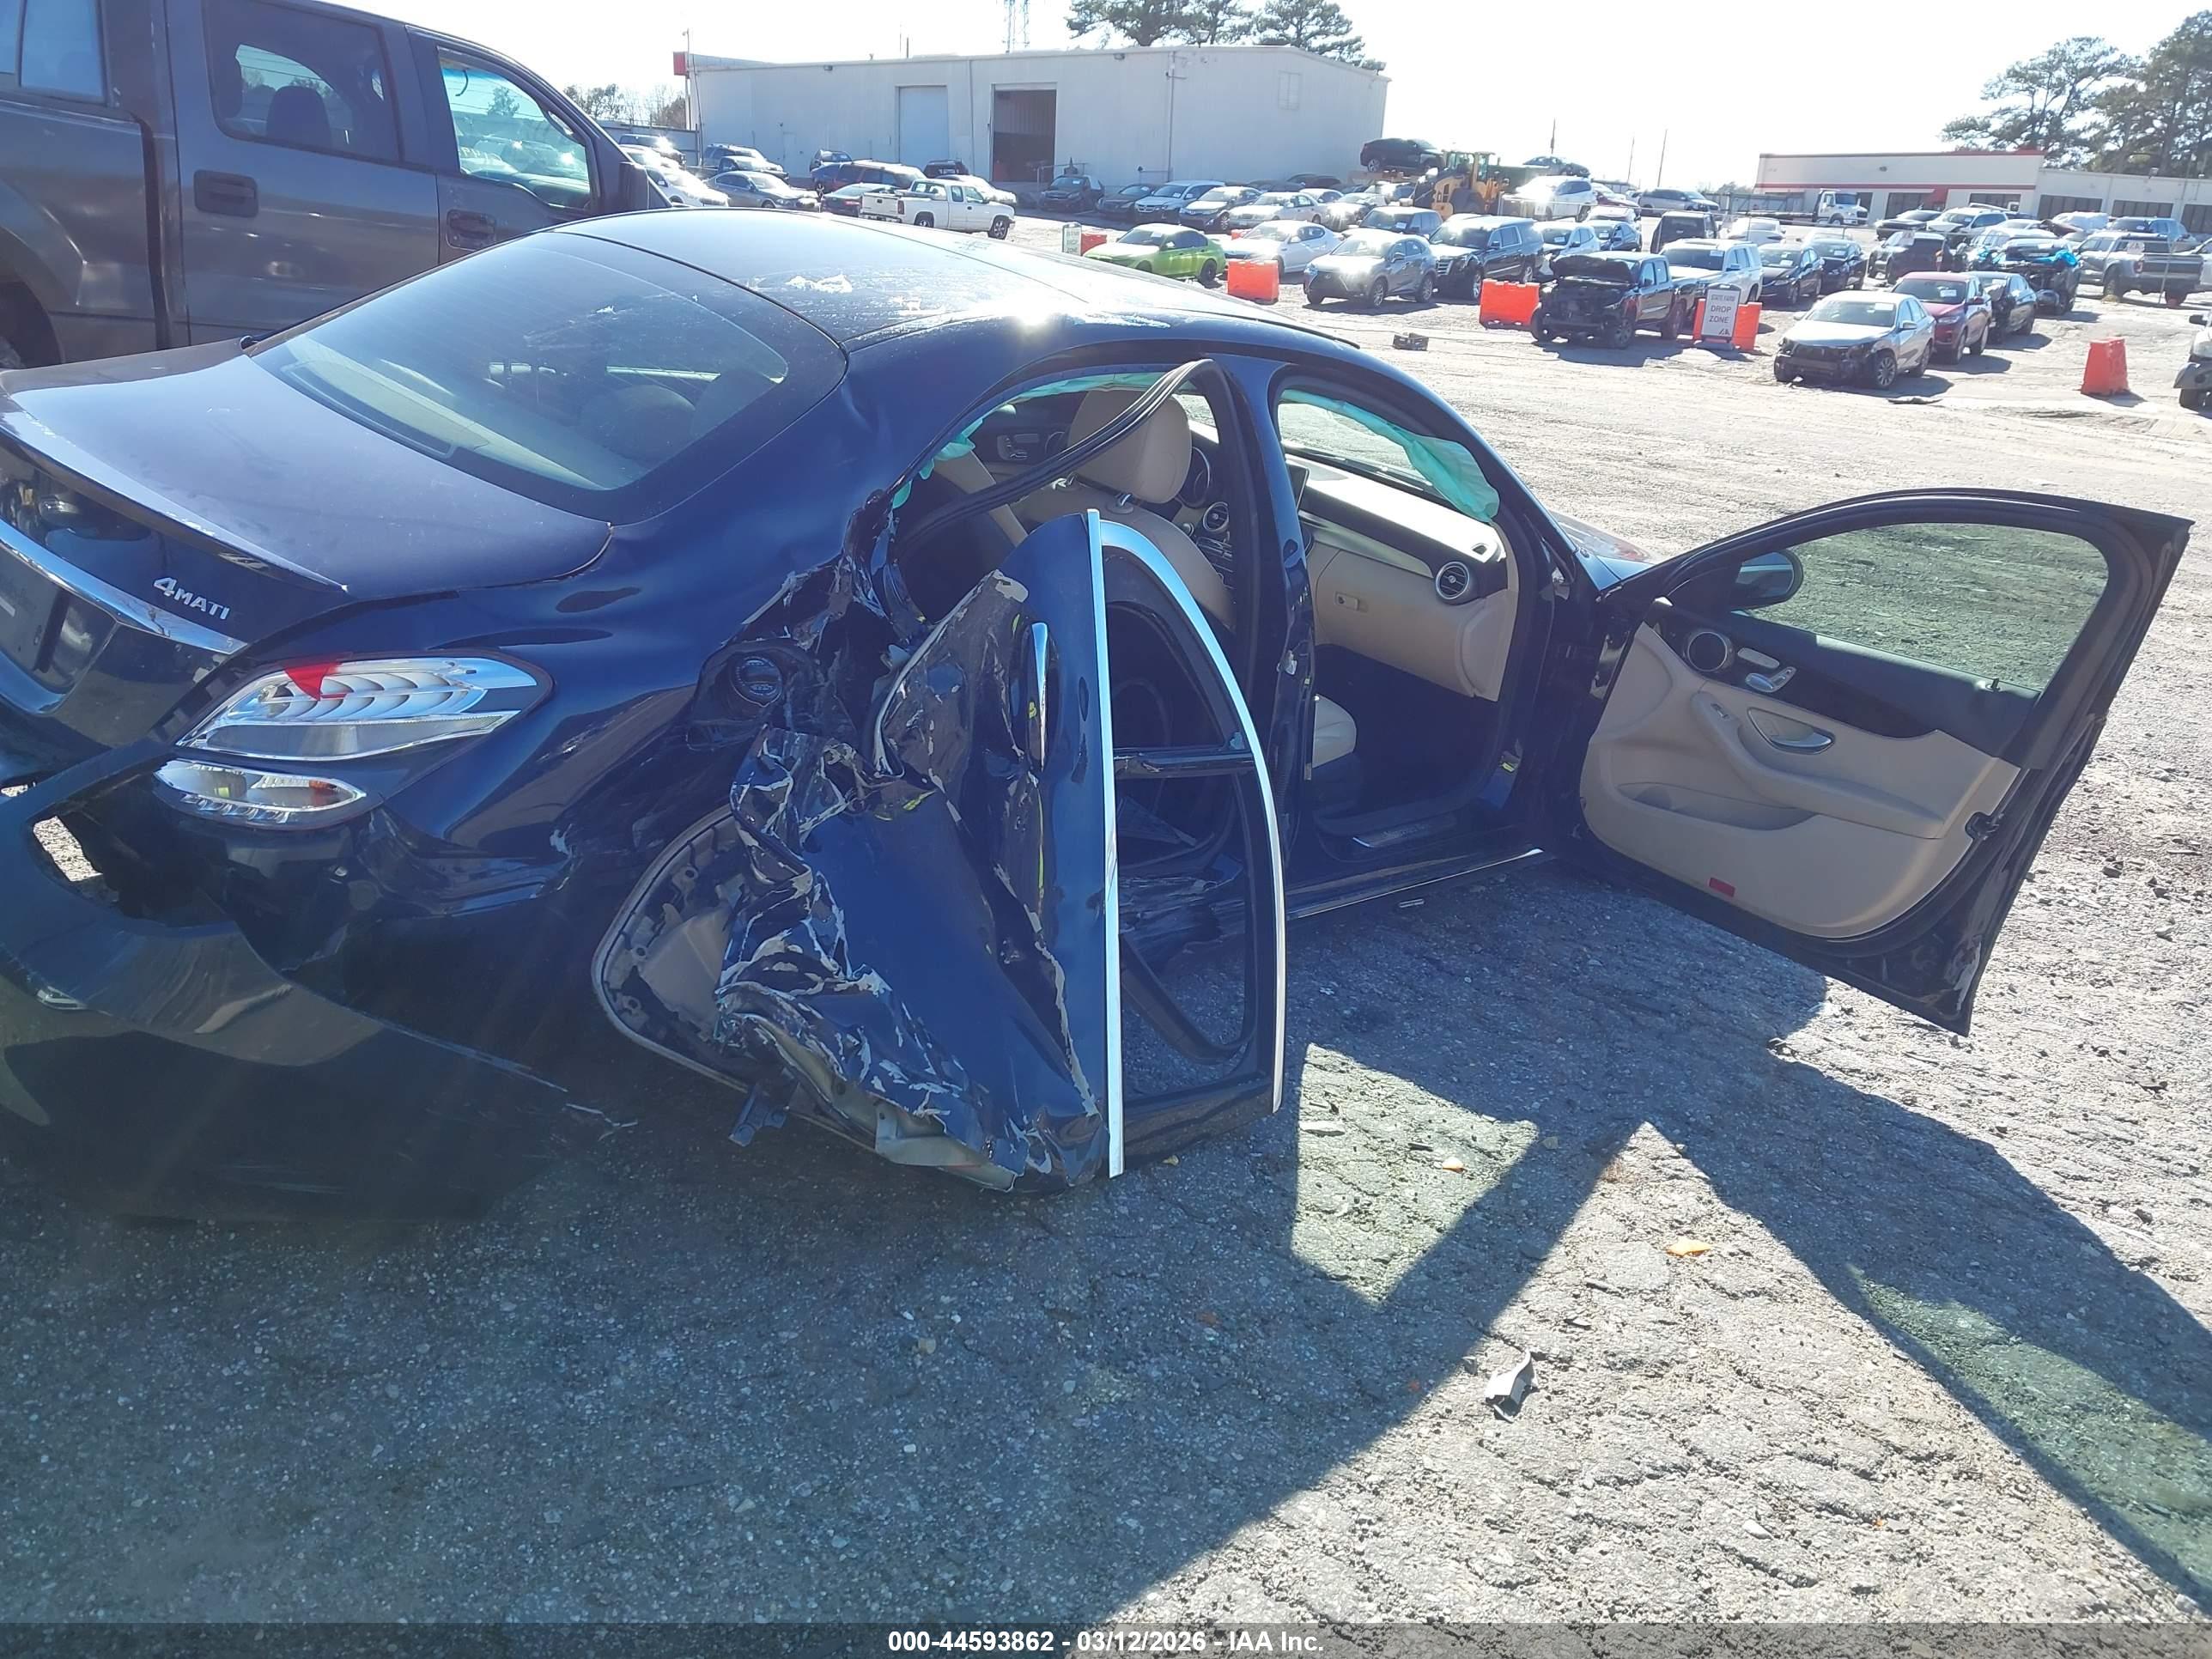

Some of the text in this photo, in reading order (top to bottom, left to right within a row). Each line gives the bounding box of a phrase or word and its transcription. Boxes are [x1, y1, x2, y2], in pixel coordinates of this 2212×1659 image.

[1711, 305, 1732, 313] DROP
[1709, 315, 1729, 324] ZONE
[154, 577, 230, 620] 4MATI
